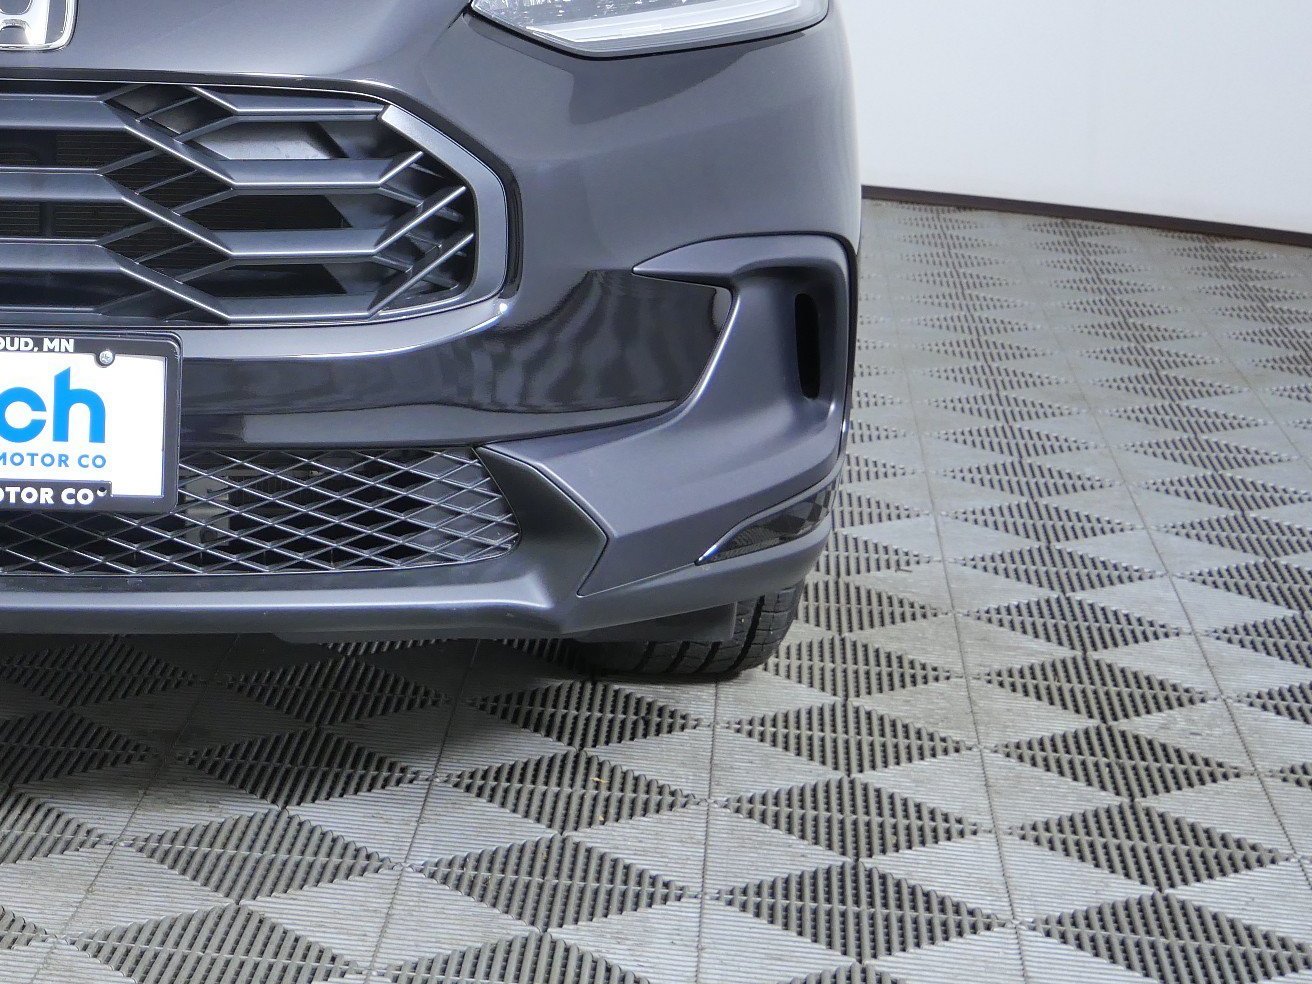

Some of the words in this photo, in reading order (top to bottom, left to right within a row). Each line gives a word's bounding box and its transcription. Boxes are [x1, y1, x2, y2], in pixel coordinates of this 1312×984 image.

[42, 338, 75, 353] MN
[77, 454, 107, 469] CO
[60, 486, 95, 506] CO
